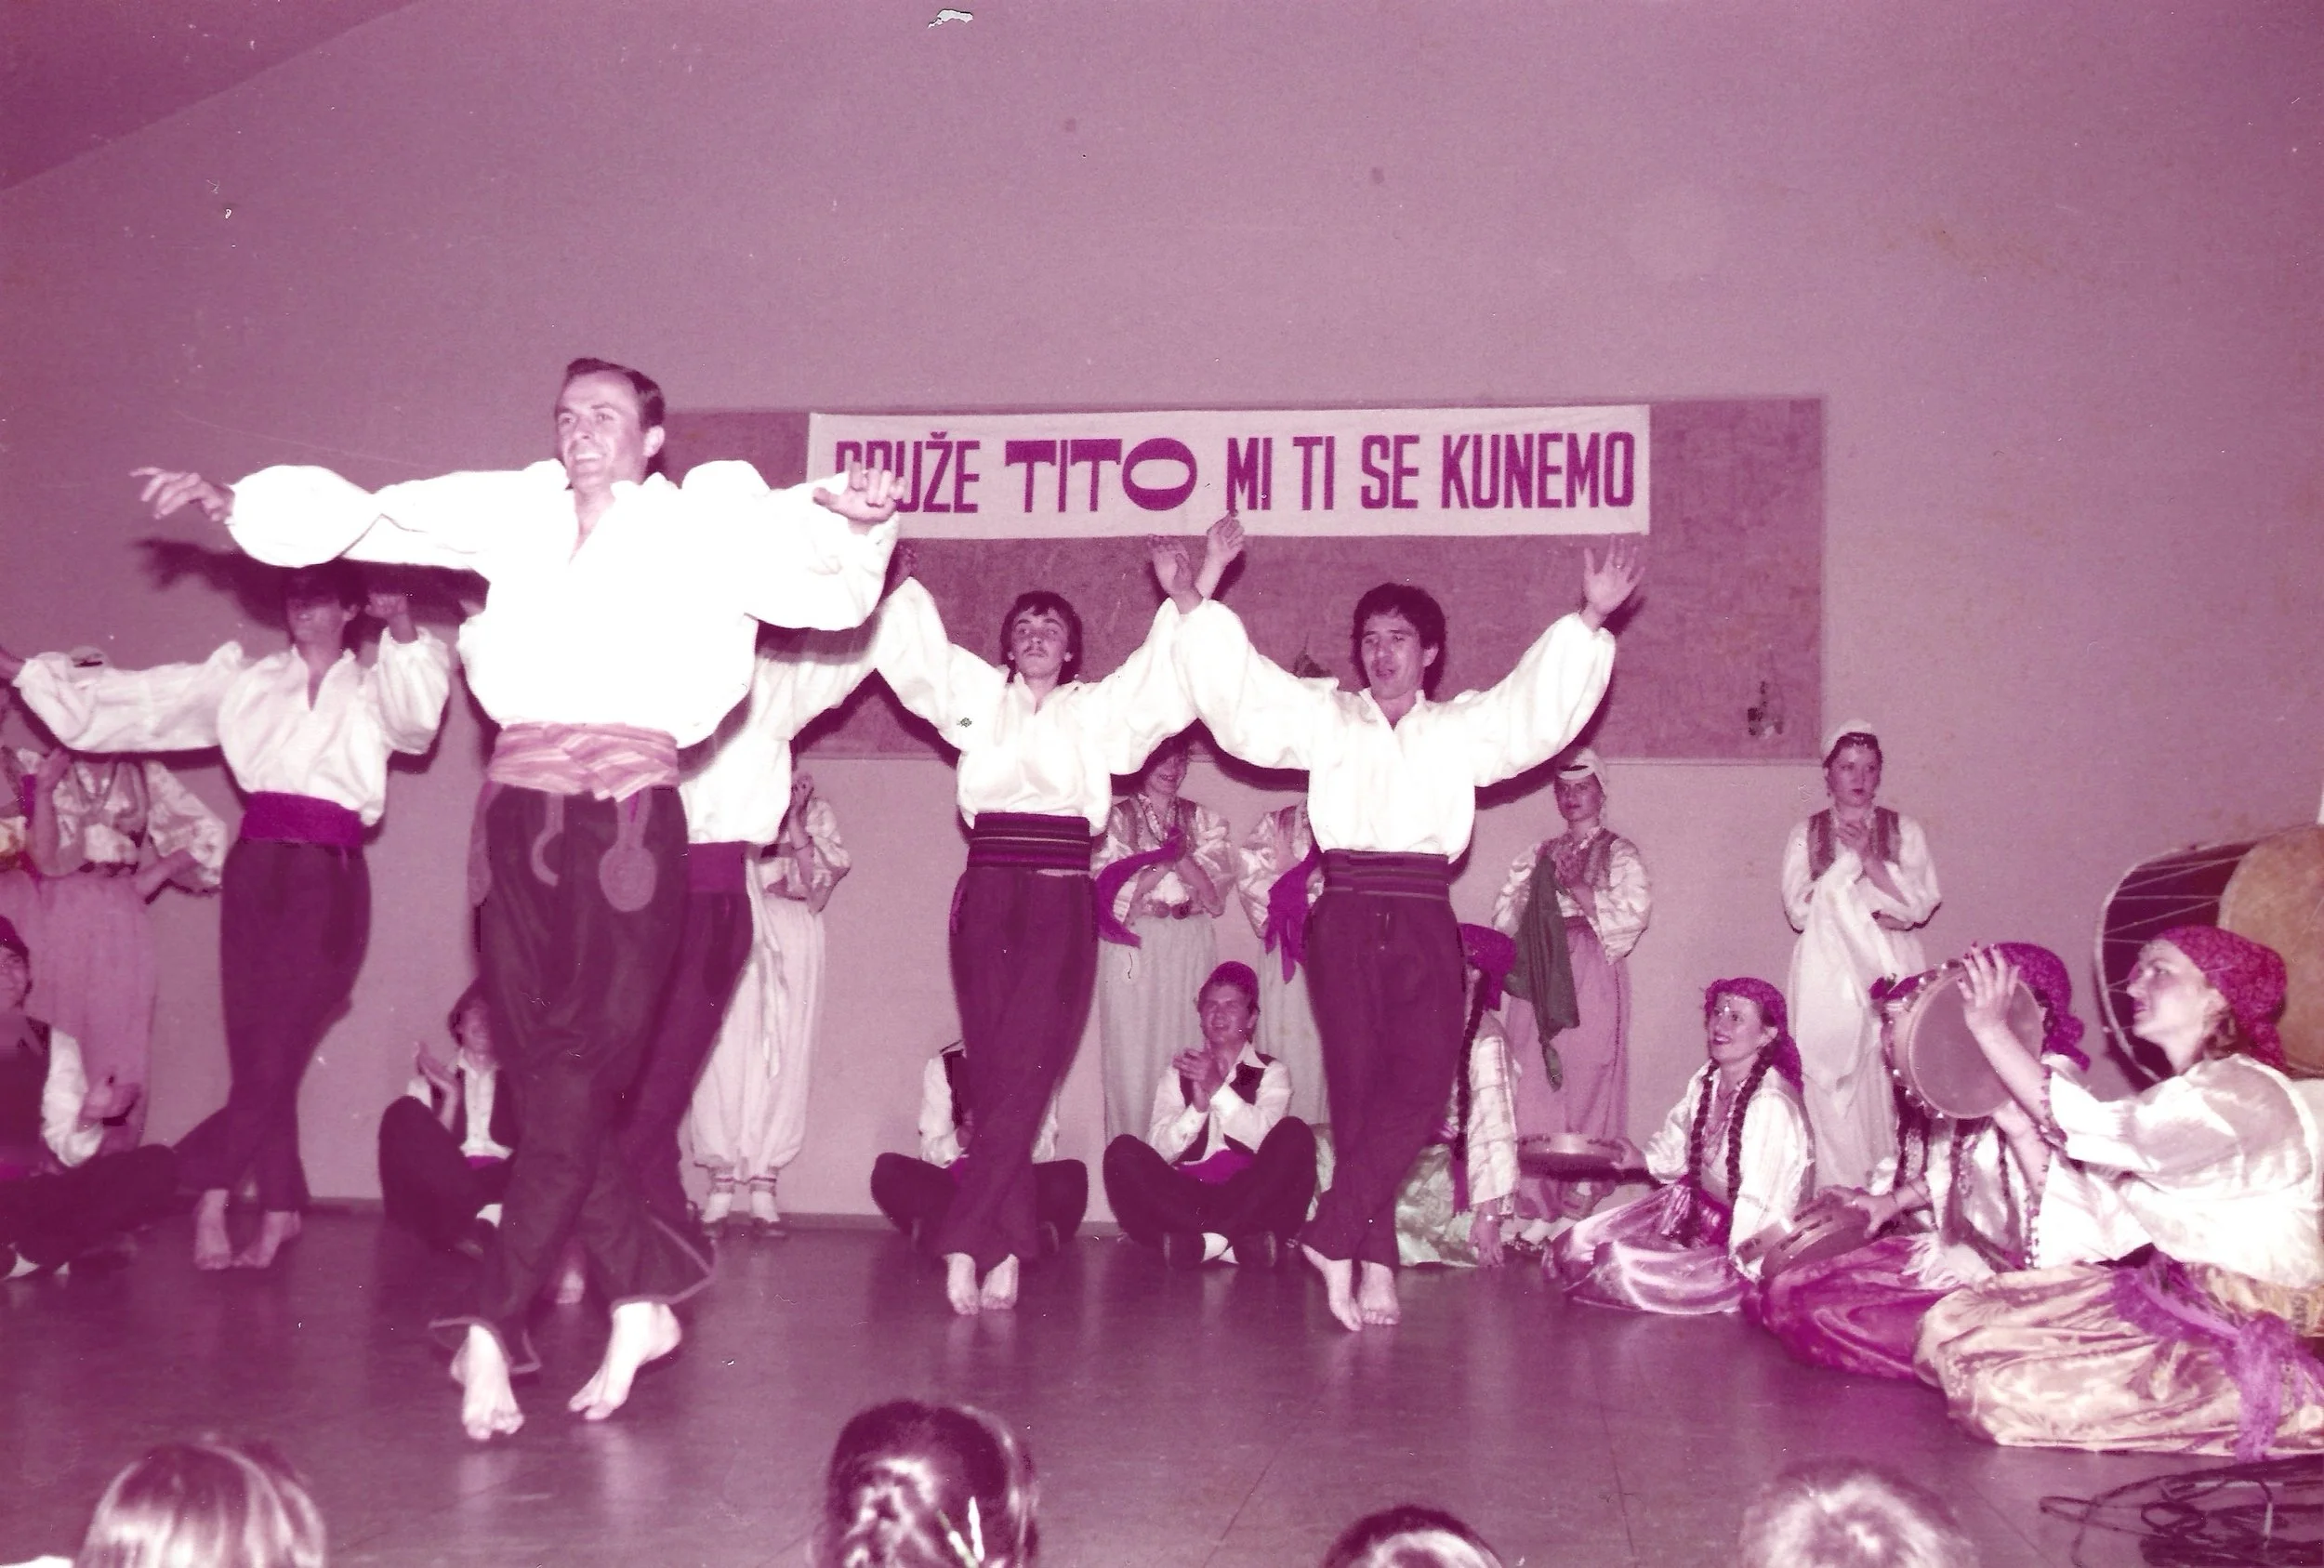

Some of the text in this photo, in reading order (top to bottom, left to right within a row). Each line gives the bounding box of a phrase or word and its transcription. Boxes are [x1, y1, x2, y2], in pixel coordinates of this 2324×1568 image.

[1005, 437, 1197, 513] TITO
[1226, 437, 1273, 510] MI
[1293, 436, 1335, 510] TI
[1361, 434, 1419, 509] SE
[1441, 431, 1634, 509] KUNEMO
